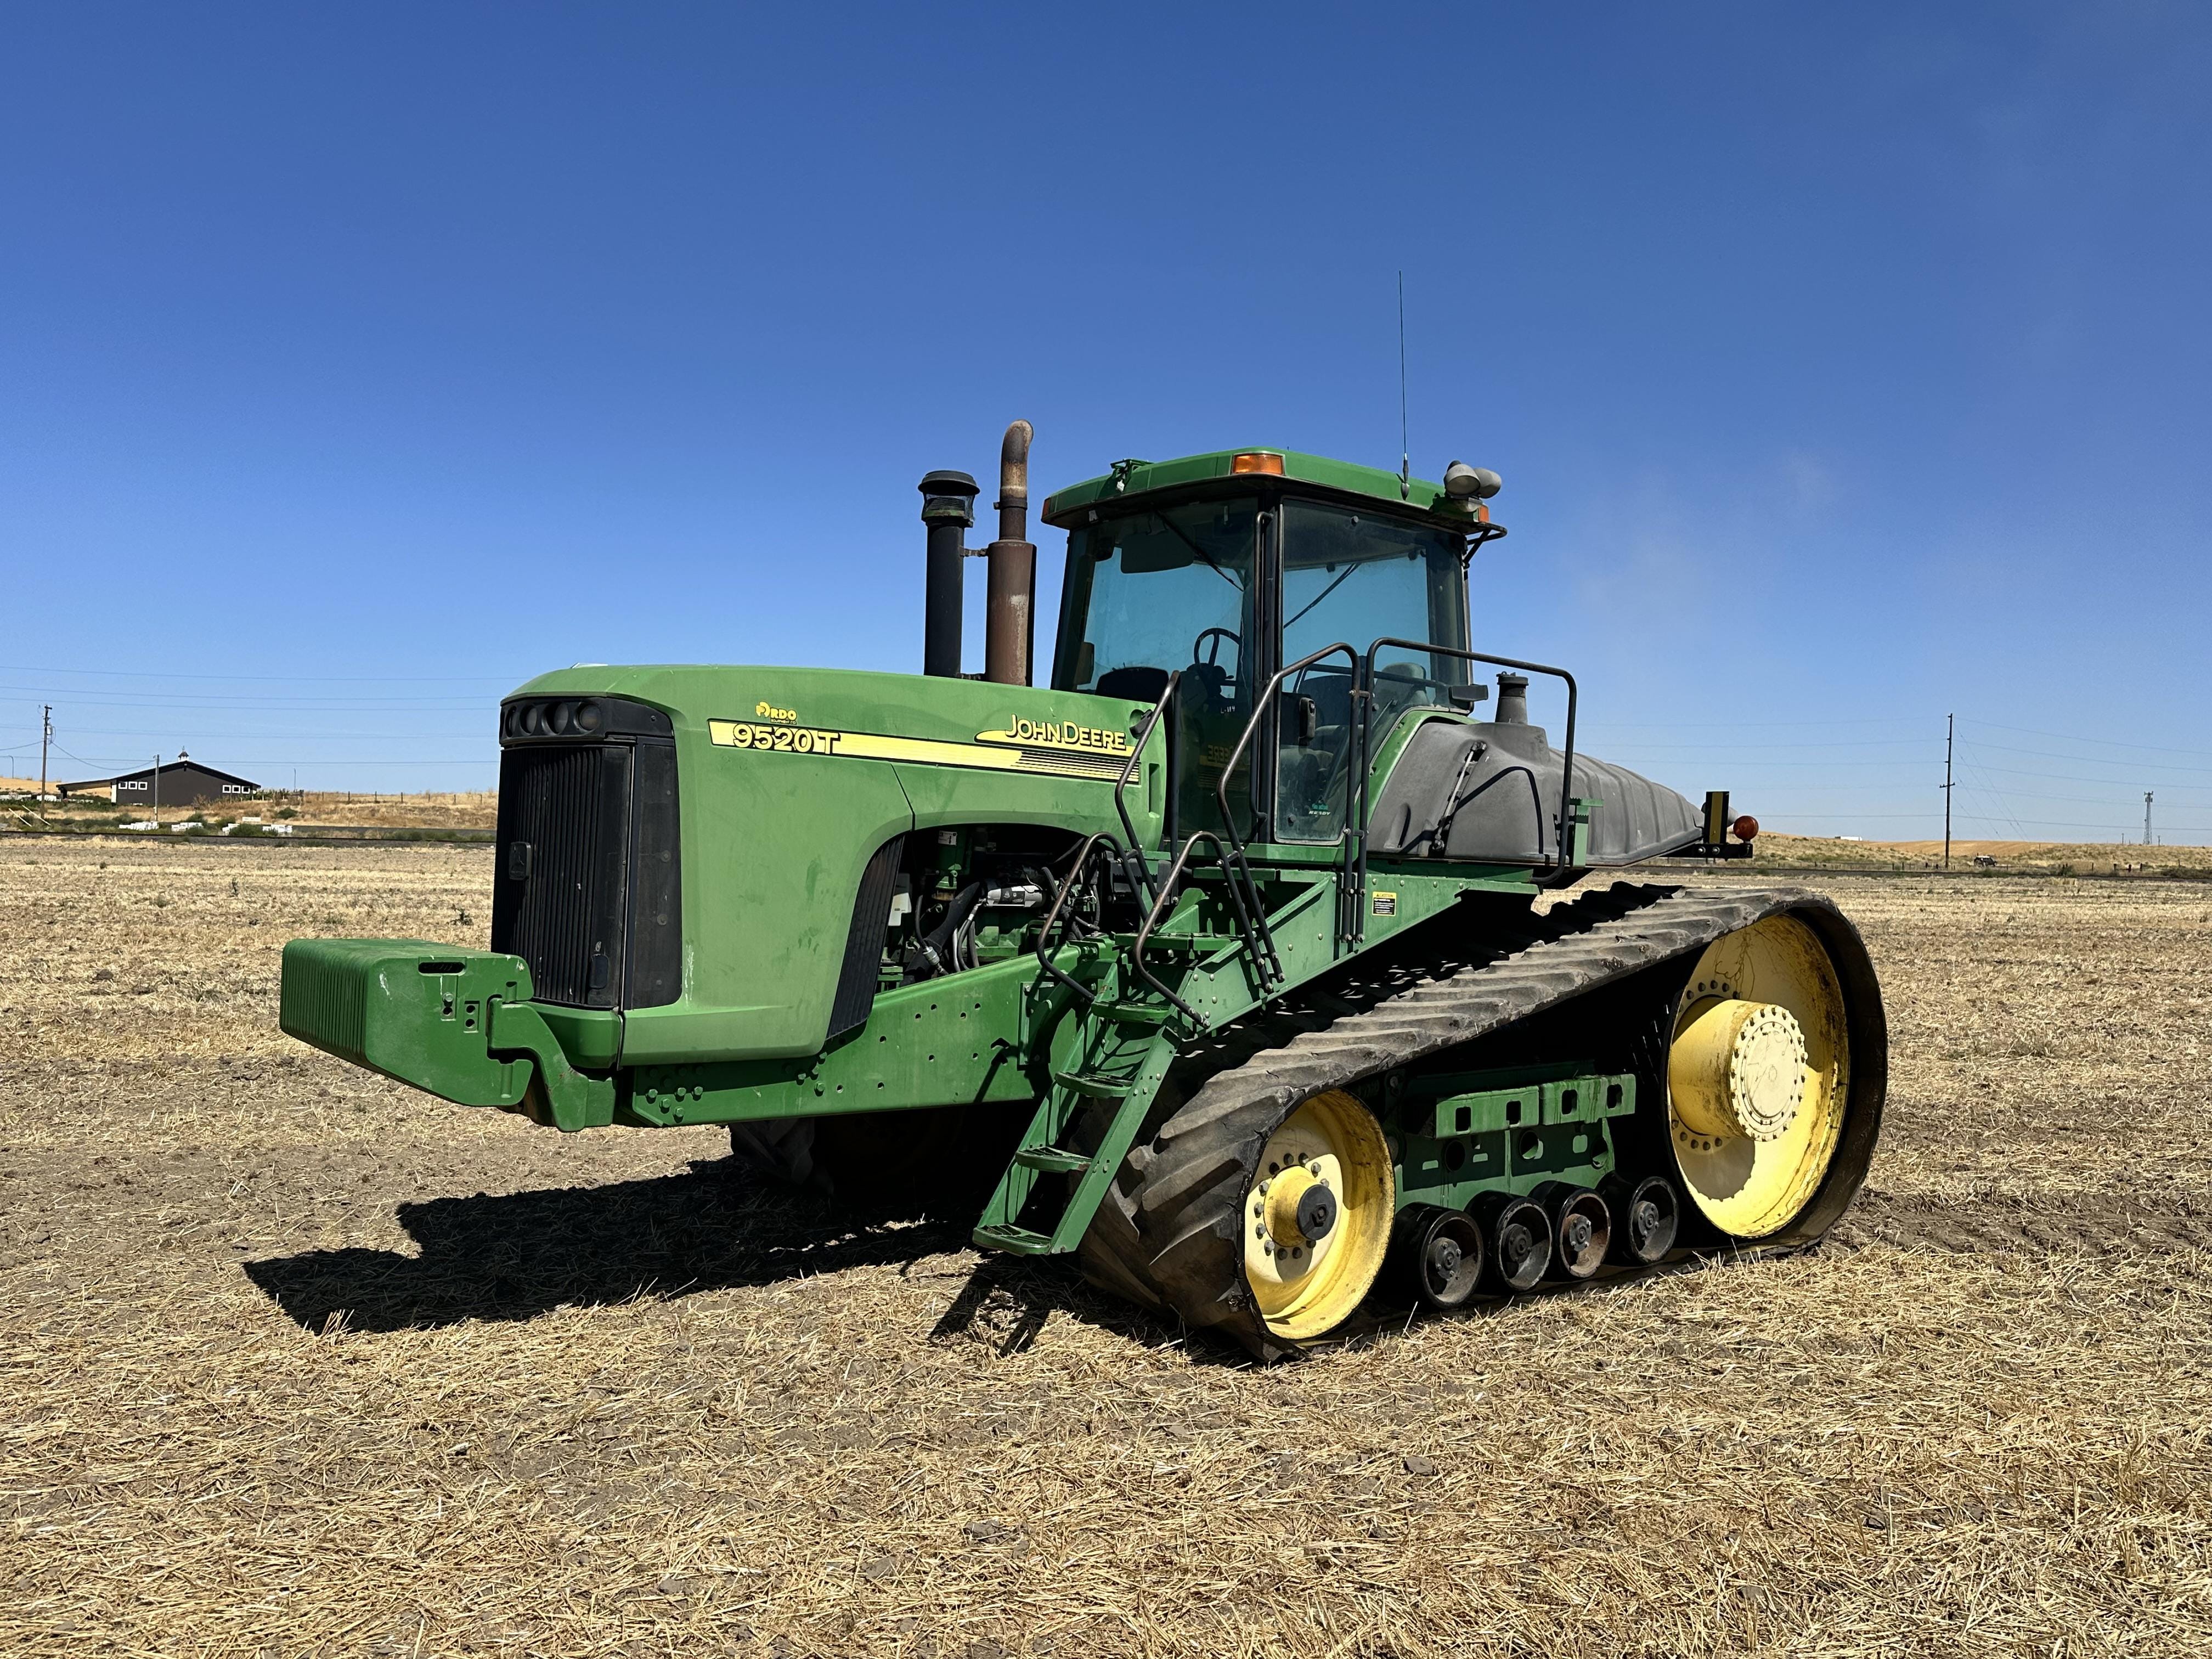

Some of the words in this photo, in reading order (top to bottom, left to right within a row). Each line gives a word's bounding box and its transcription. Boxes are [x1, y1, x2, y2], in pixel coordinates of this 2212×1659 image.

[733, 723, 840, 754] 9520T
[1005, 714, 1062, 743] JOHN
[1063, 720, 1126, 751] DEERE
